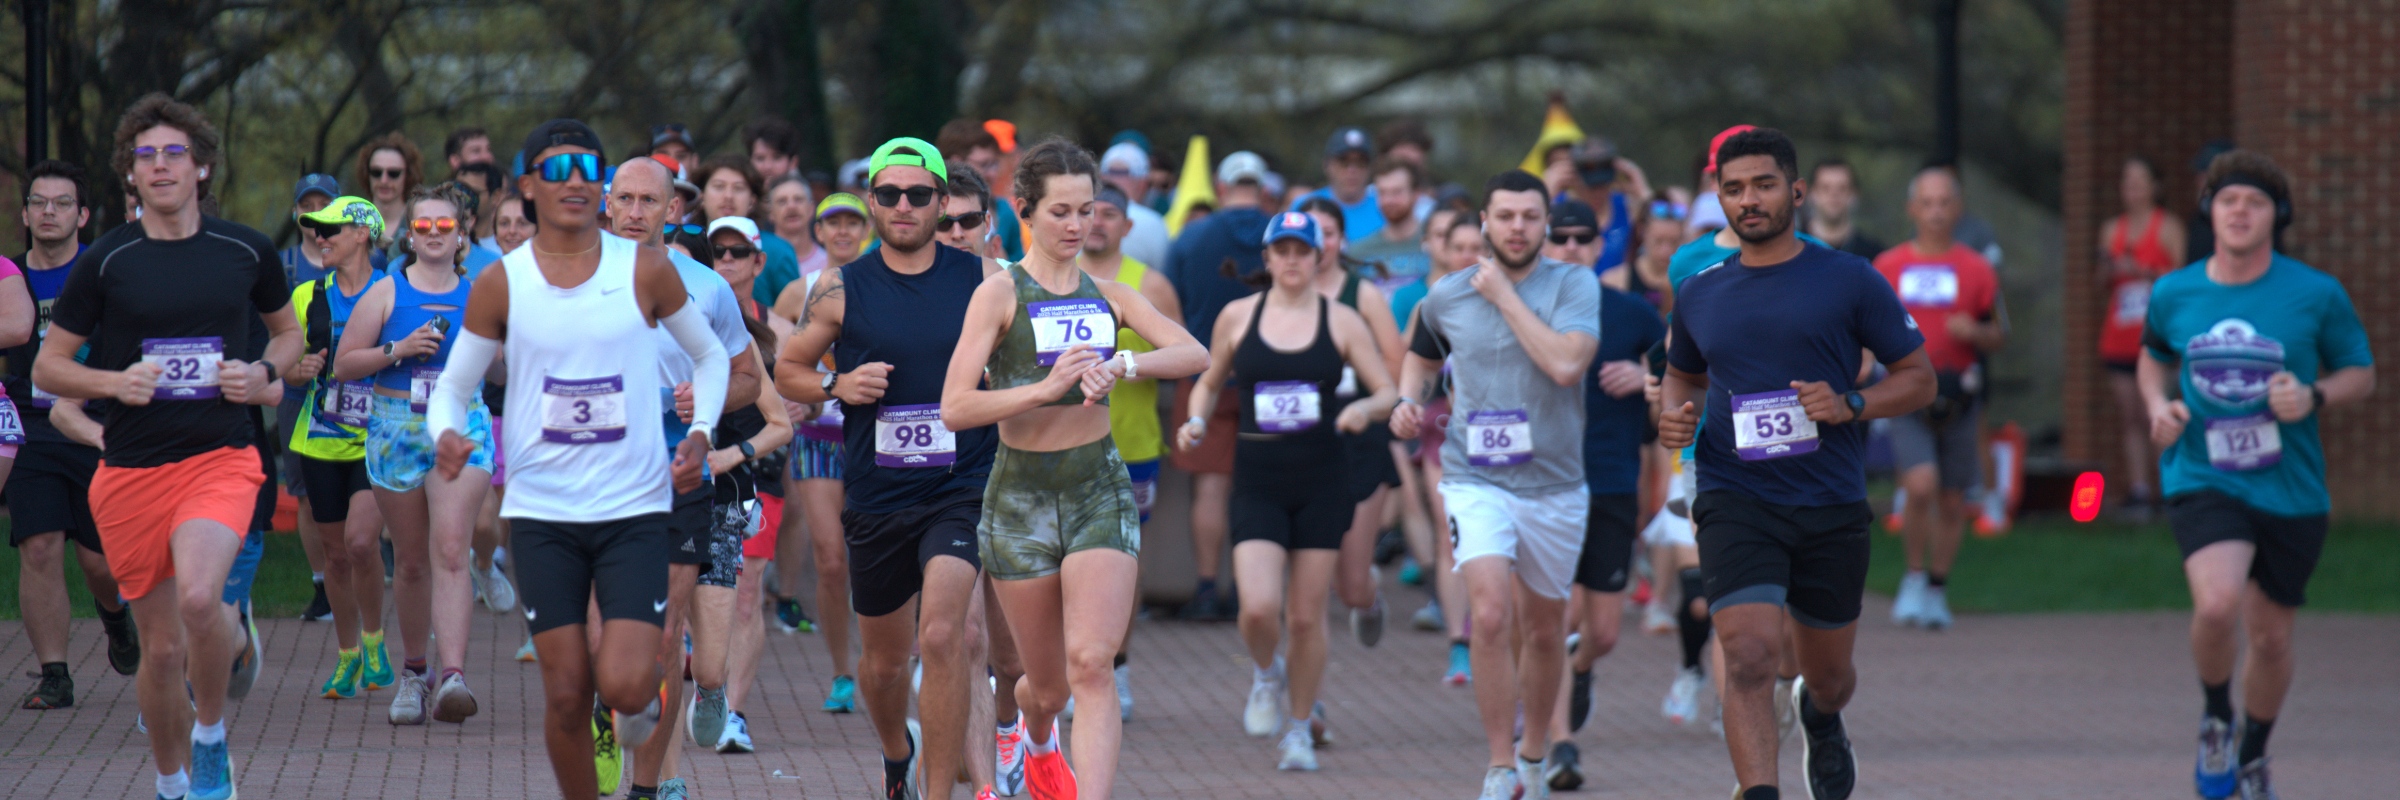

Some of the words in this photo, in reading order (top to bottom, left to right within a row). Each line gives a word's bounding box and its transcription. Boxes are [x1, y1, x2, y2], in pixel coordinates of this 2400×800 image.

[1040, 304, 1077, 312] CATAMOUNT
[1056, 318, 1092, 343] 76
[166, 358, 201, 381] 32
[423, 381, 433, 399] 1
[341, 394, 368, 413] 84
[573, 399, 591, 424] 3
[1274, 396, 1301, 414] 92
[1741, 396, 1779, 407] CATAMOUNT
[1755, 411, 1793, 438] 53
[895, 424, 933, 449] 98
[1482, 427, 1511, 448] 86
[2225, 428, 2260, 452] 121
